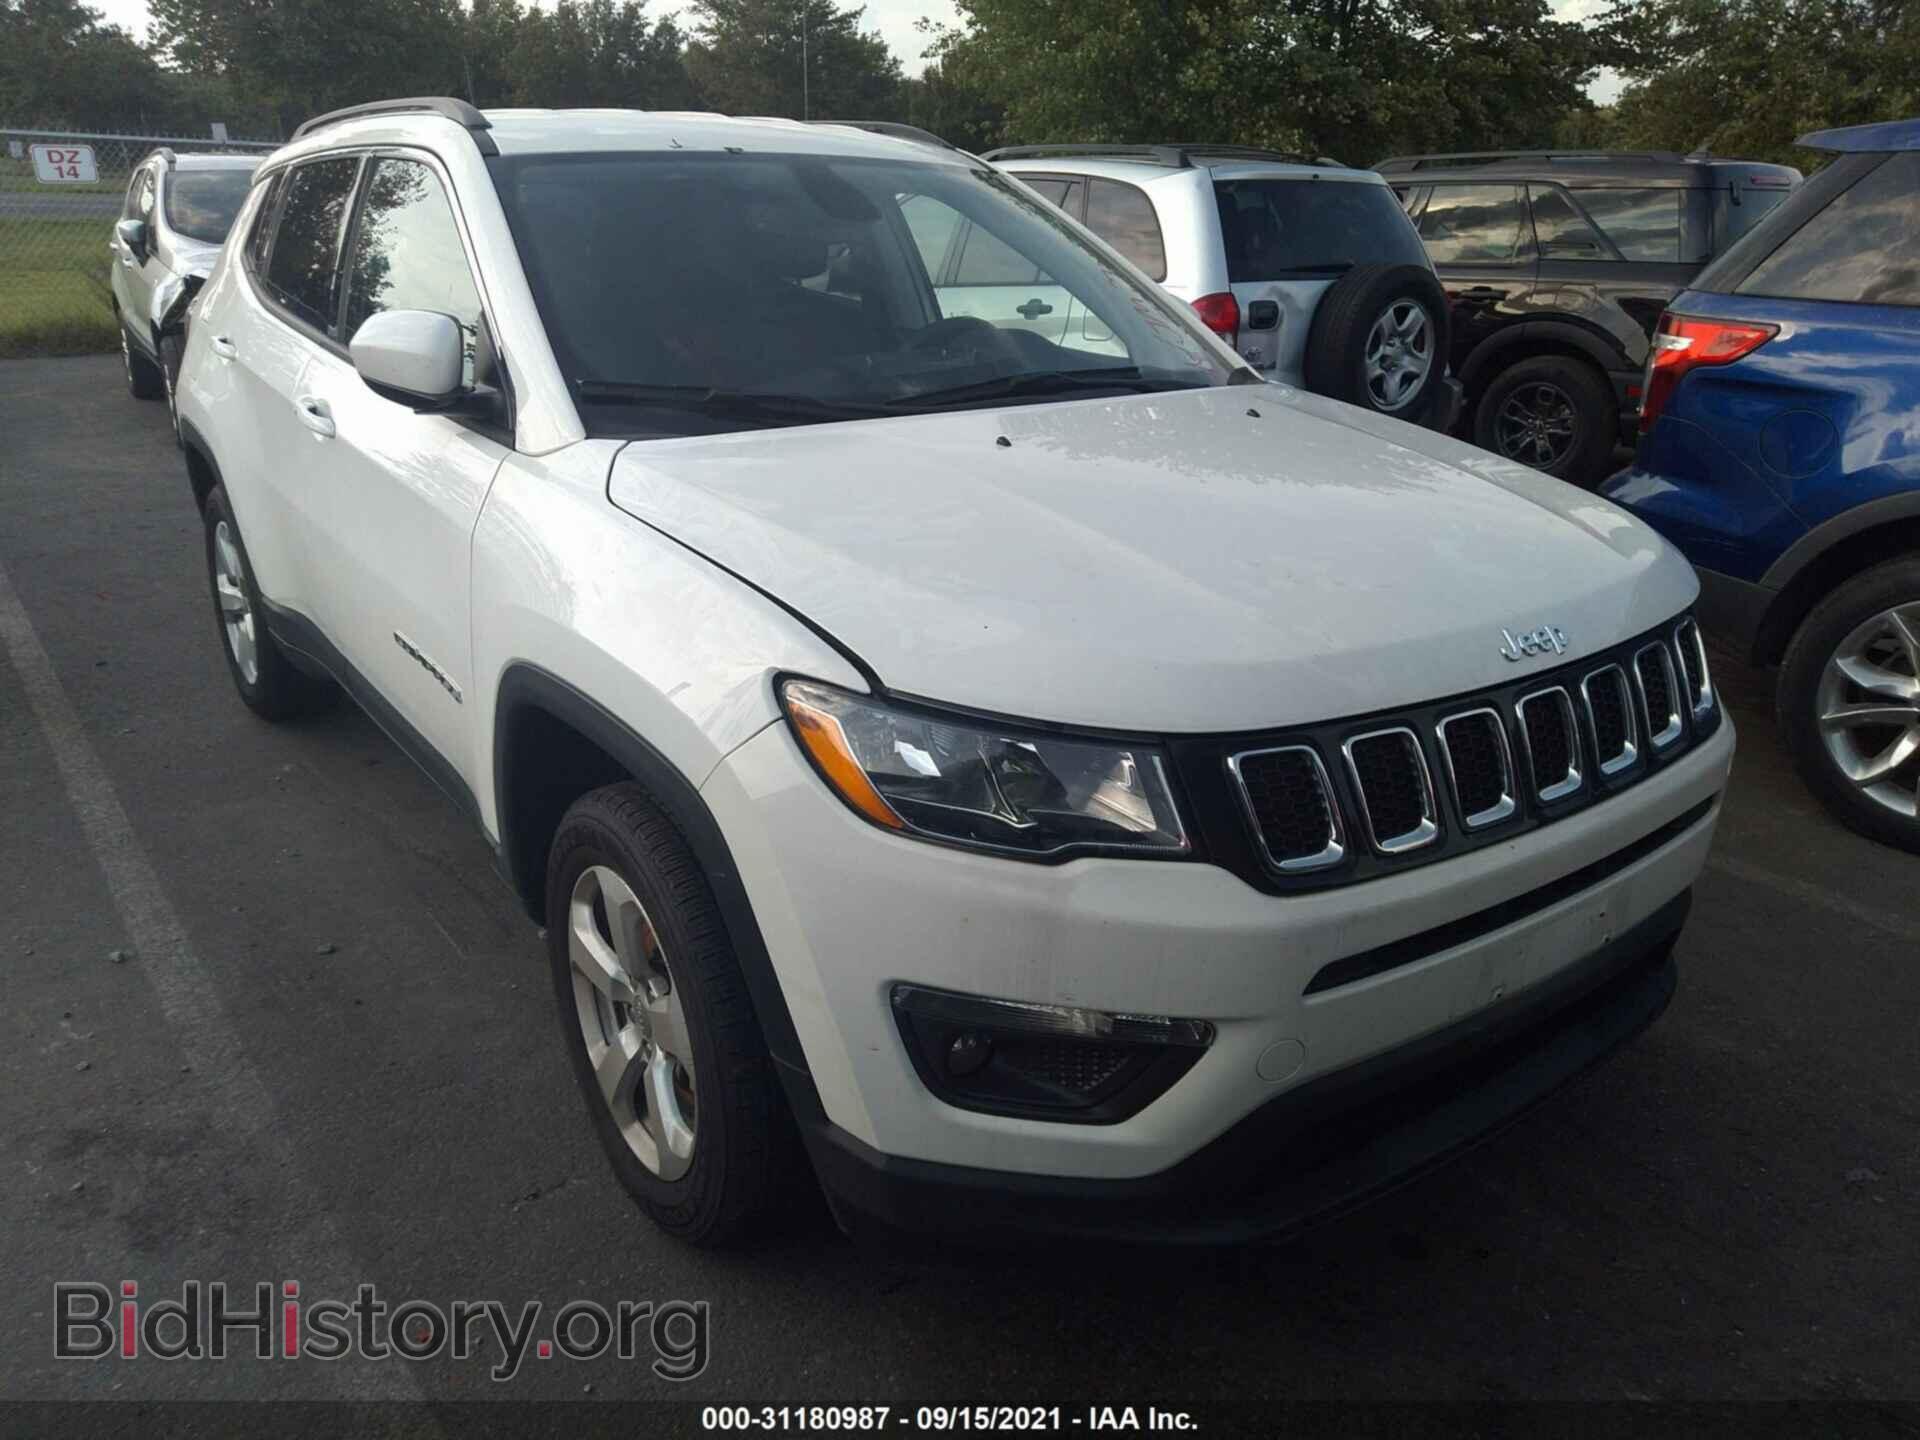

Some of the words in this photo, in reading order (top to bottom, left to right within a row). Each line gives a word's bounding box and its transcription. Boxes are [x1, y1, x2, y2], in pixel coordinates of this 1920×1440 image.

[47, 150, 82, 164] DZ
[54, 166, 80, 178] 14
[1499, 625, 1570, 662] Jeep
